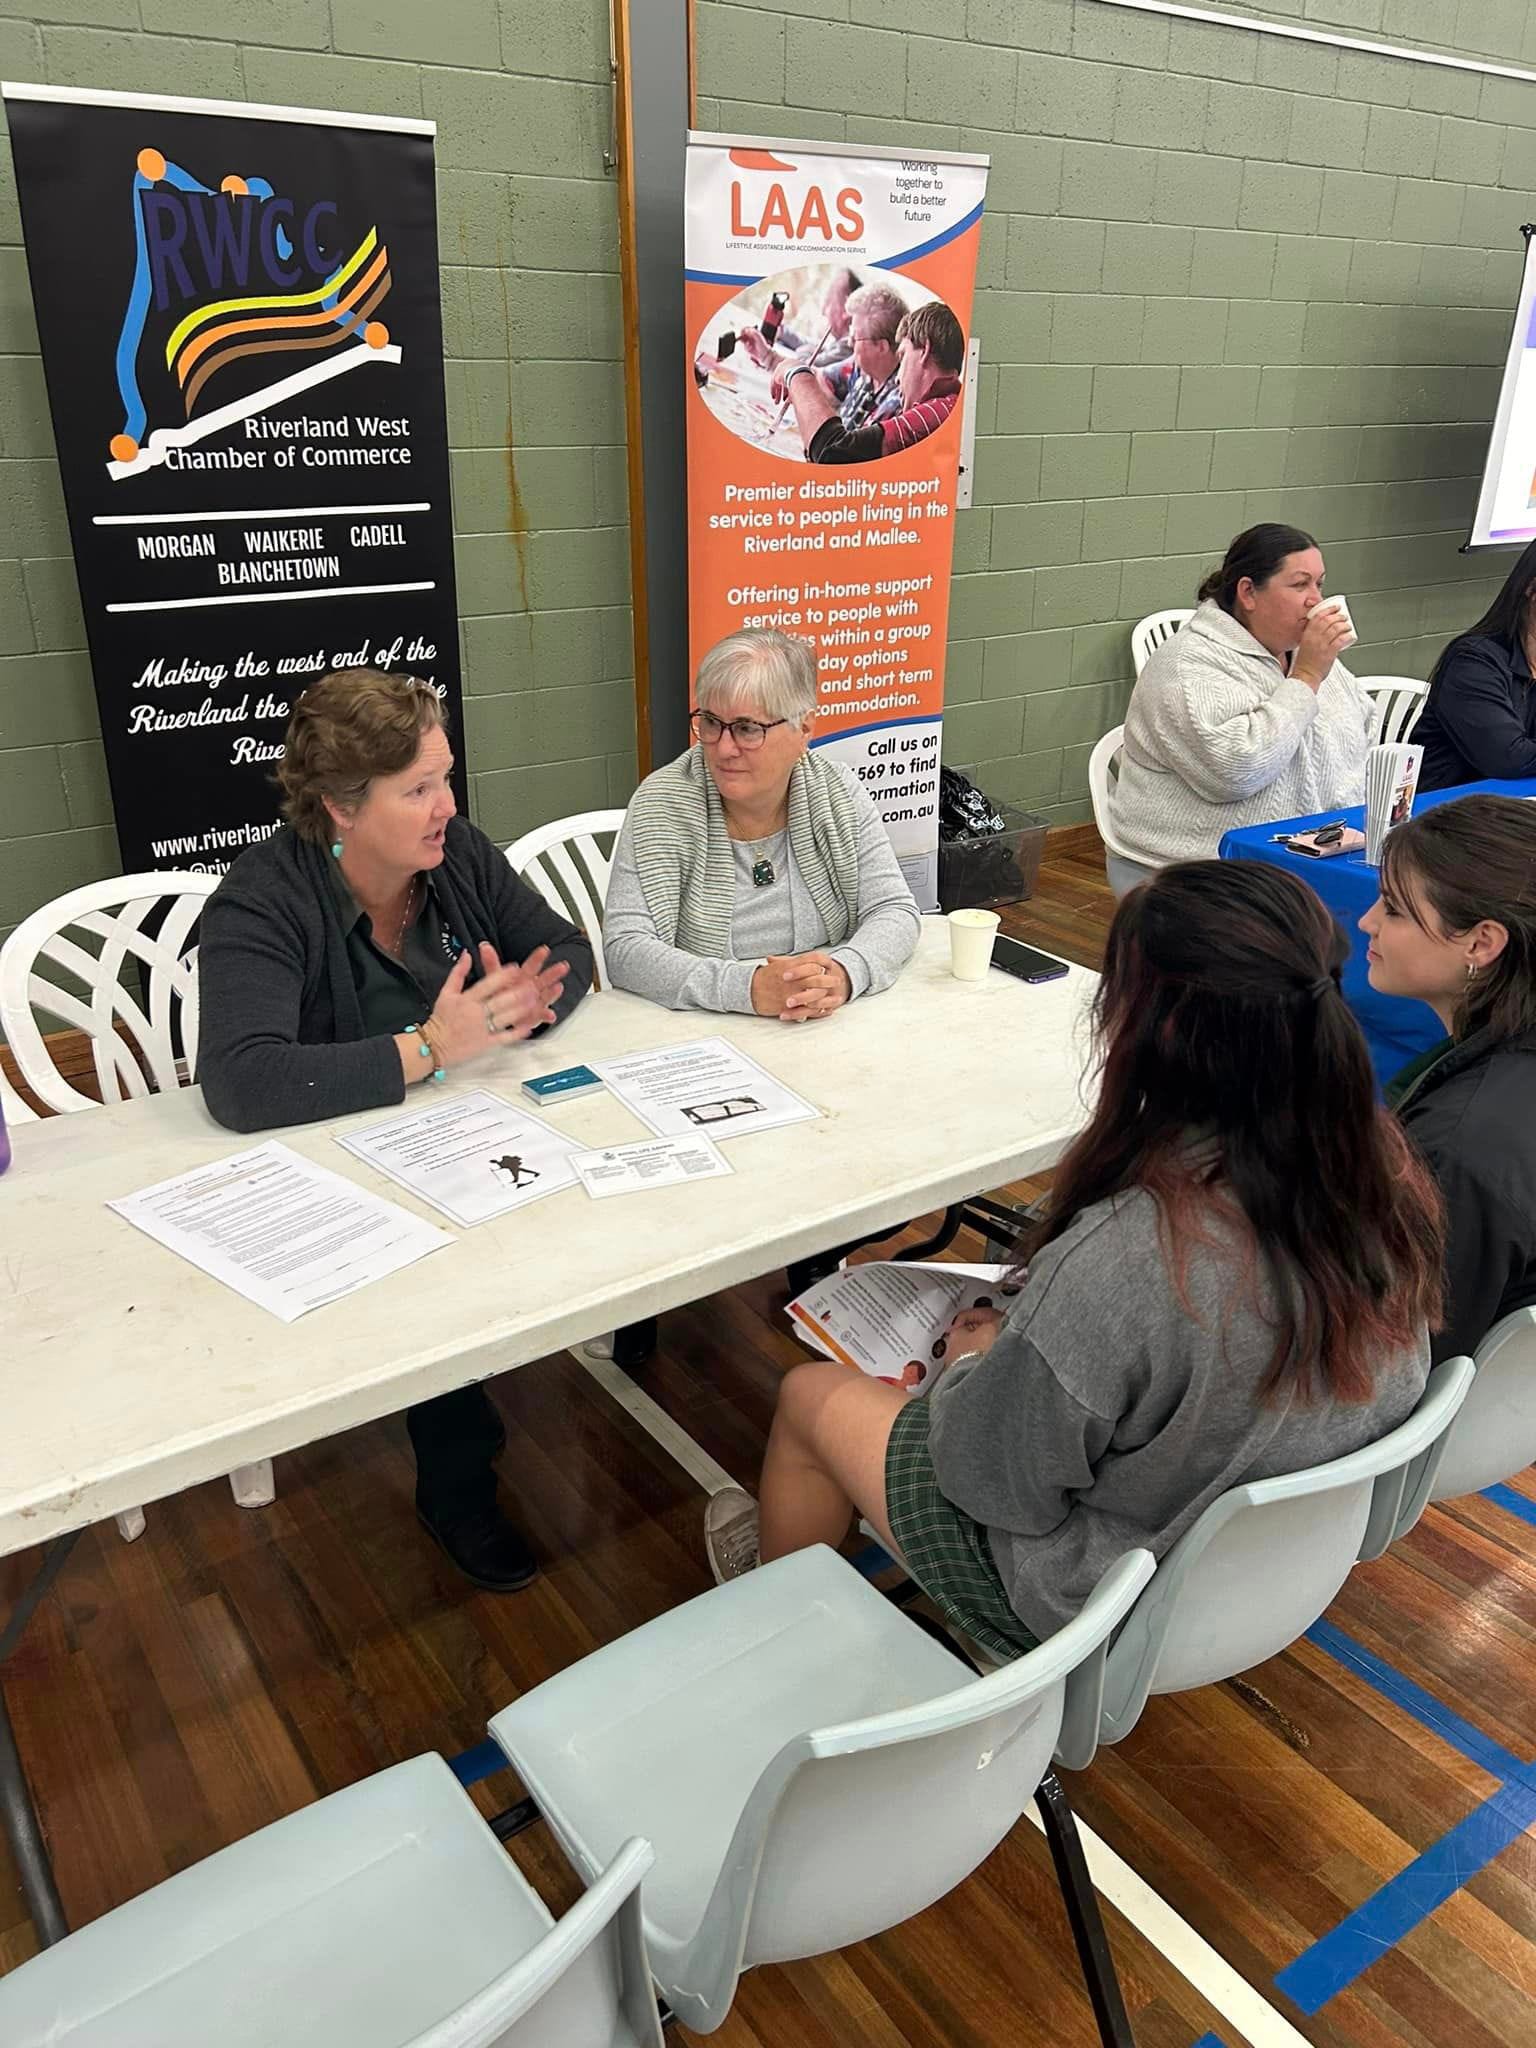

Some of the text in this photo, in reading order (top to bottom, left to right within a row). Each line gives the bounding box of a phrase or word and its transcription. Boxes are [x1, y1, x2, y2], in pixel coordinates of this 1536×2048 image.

[901, 160, 938, 175] Working
[896, 176, 943, 190] together to
[731, 181, 865, 241] LAAS
[890, 192, 947, 206] build a better
[905, 210, 931, 221] future
[138, 188, 344, 312] RWCC
[725, 242, 752, 250] LIFESTYLE
[753, 243, 784, 251] ASSISTANCE
[796, 244, 846, 253] ACCOMMODATION
[847, 246, 867, 254] SERVICE
[244, 417, 411, 439] Riverland West
[164, 445, 412, 470] Chamber of Commerce
[725, 477, 941, 502] Premier disability support
[709, 501, 948, 529] service to people living in the
[137, 524, 407, 560] MORGAN WAIKERIE CADELL
[744, 528, 921, 554] Riverland and Mallee.
[218, 556, 340, 585] BLANCHETOWN
[727, 574, 933, 606] Offering in-home support
[743, 599, 918, 629] service to people with
[820, 626, 870, 647] within
[874, 629, 884, 641] a
[888, 622, 931, 644] group
[132, 636, 436, 689] Making the west end of the
[818, 649, 908, 672] day options
[821, 667, 933, 693] and short term
[127, 694, 249, 734] Riverland
[254, 692, 289, 720] the
[230, 736, 286, 765] Rive
[868, 735, 937, 757] Call us on
[853, 753, 936, 781] 569 to find
[866, 779, 935, 801] ormation
[882, 804, 934, 823] com.au
